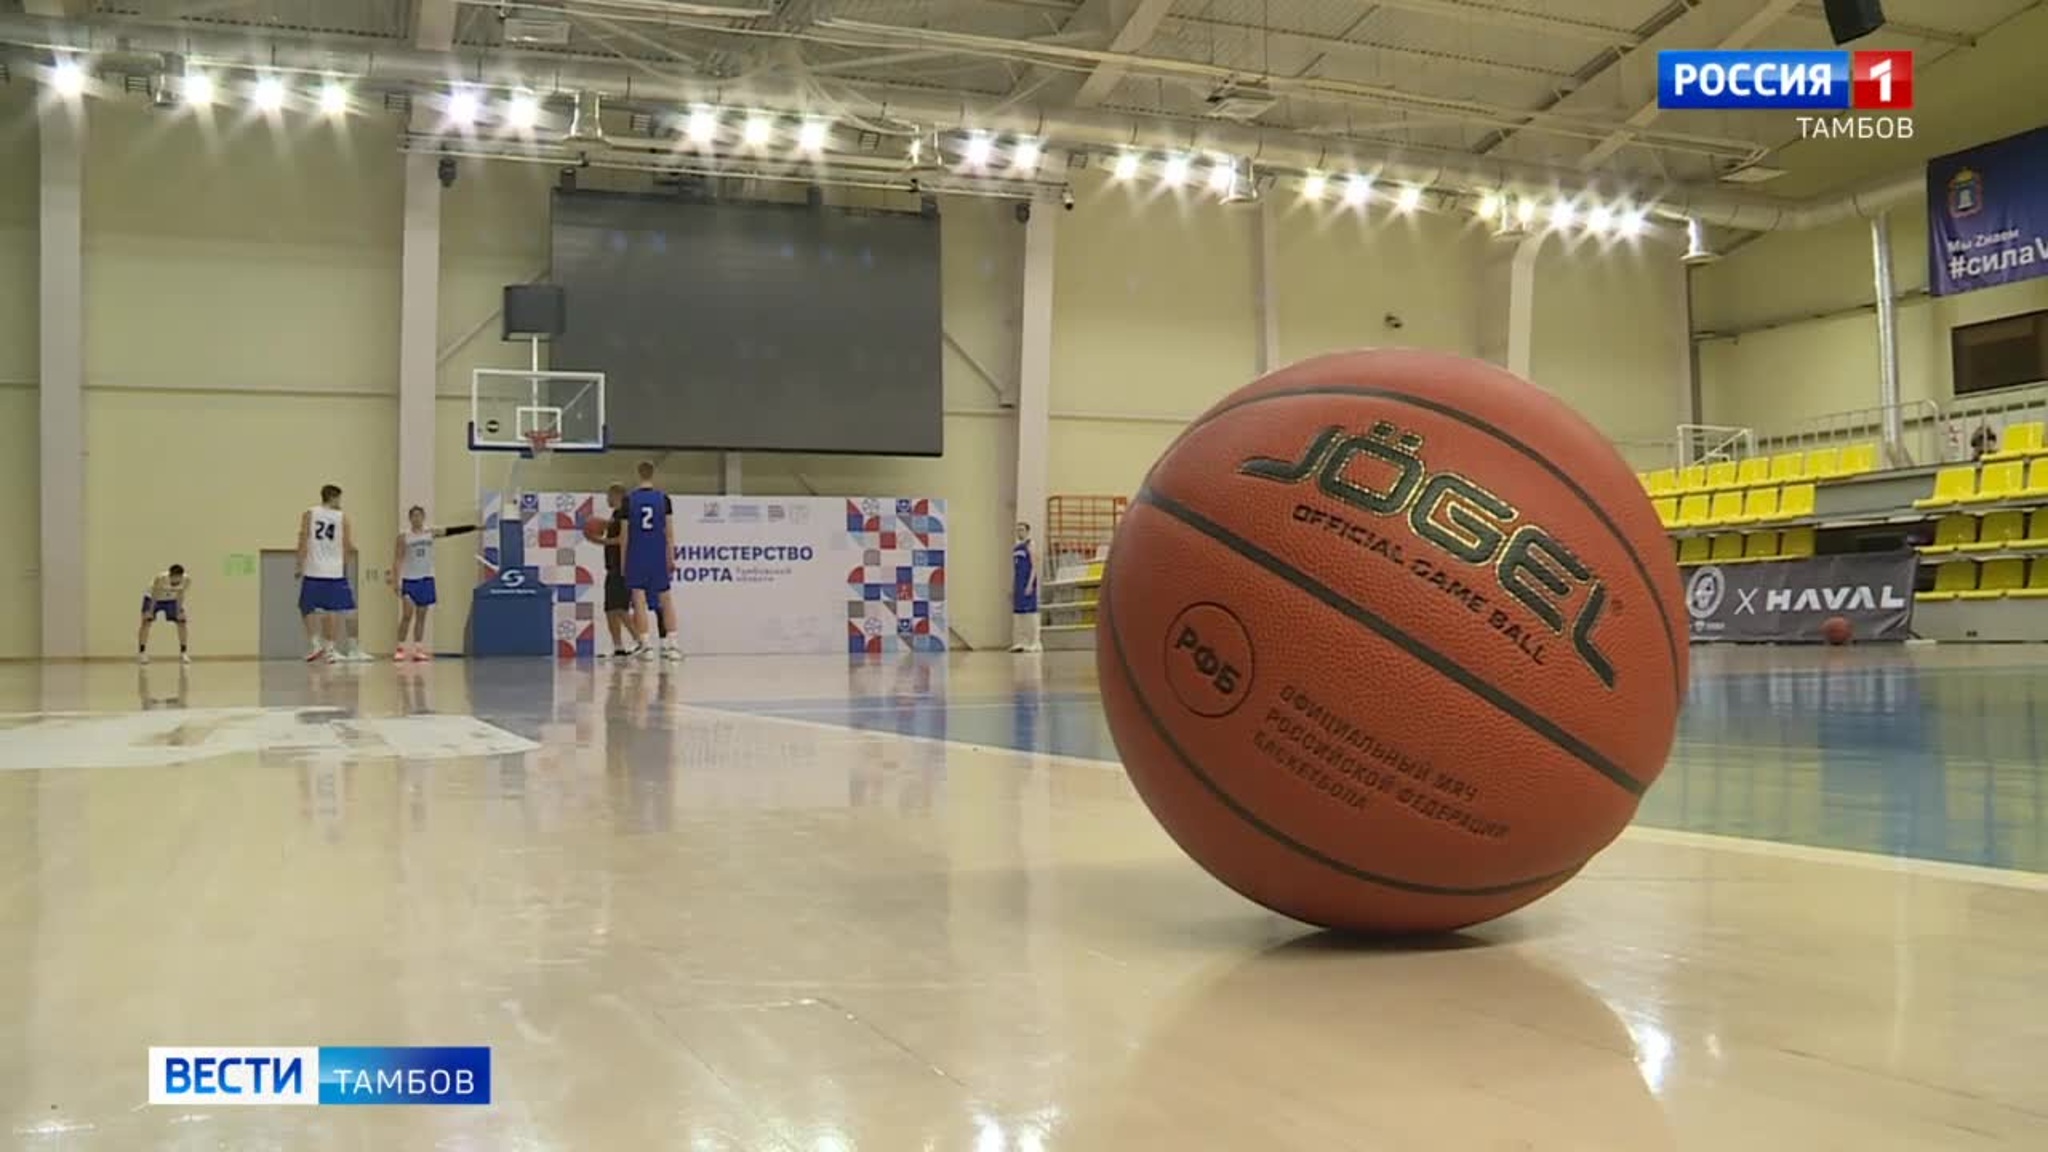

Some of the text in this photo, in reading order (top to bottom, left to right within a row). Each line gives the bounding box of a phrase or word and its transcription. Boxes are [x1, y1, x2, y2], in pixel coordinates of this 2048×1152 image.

[314, 521, 335, 541] 24
[641, 506, 654, 530] 2
[673, 545, 814, 561] ИНИСТЕРСТВО
[669, 567, 733, 582] ПОРТА
[1236, 420, 1615, 691] JÖGEL
[1291, 503, 1546, 666] OFFICIAL GAME BALL
[1765, 585, 1907, 612] HAVAL
[1174, 625, 1242, 695] РФБ
[1252, 730, 1371, 811] БАСКЕТБОЛА
[1265, 707, 1510, 838] РОССИЙСКОЙ ФЕДЕРАЦИИ
[1279, 684, 1478, 803] ОФИЦИАЛЬНЫЙ МЯЧ
